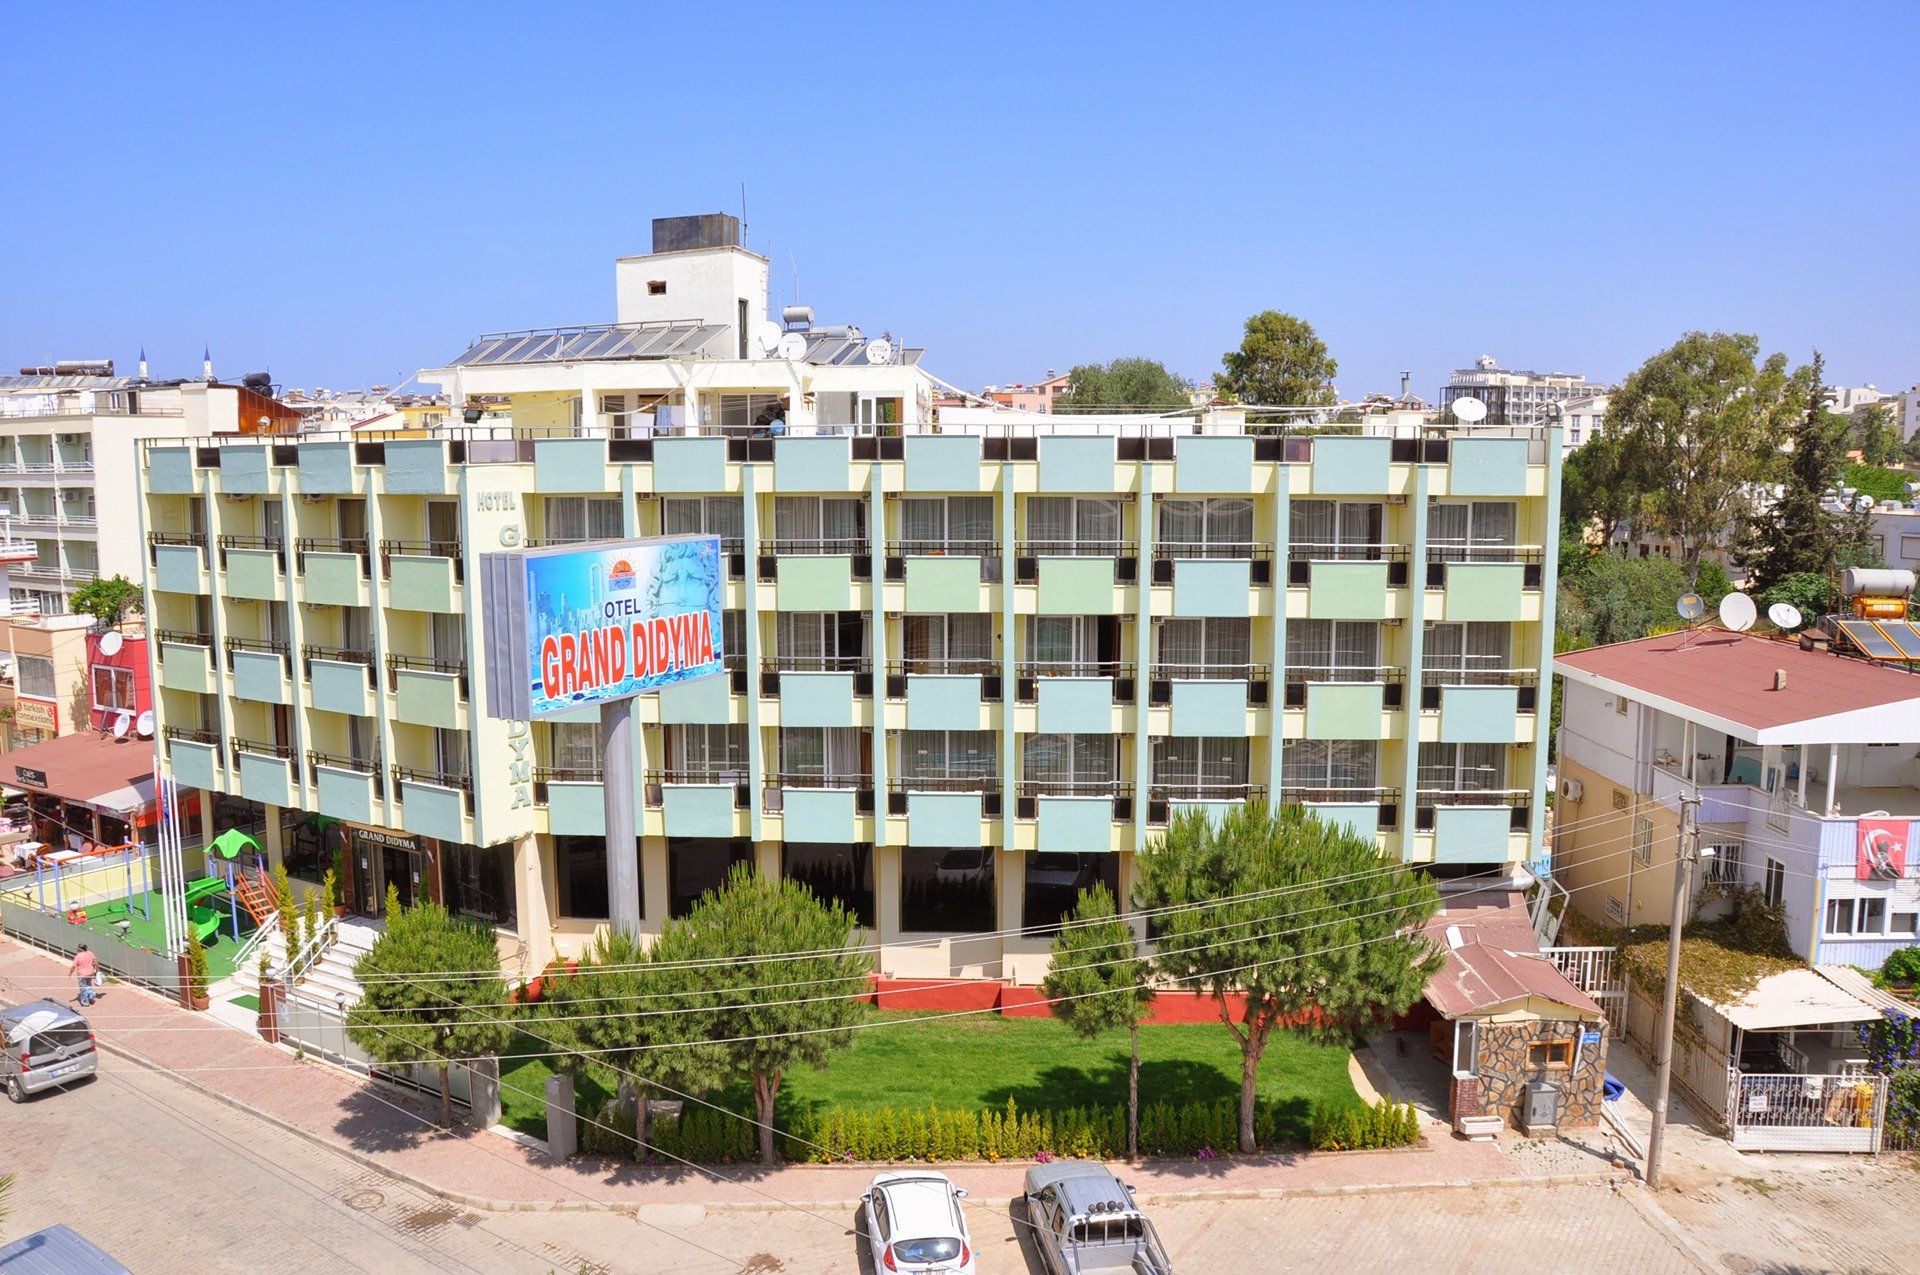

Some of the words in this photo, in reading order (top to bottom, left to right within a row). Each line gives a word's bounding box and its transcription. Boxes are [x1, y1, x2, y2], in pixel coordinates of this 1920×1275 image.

[477, 491, 516, 511] HOTEL
[604, 598, 641, 619] OTEL
[541, 624, 626, 700] GRAND
[632, 610, 714, 679] DIDYMA
[358, 829, 385, 843] GRAND
[385, 835, 416, 850] DIDYMA
